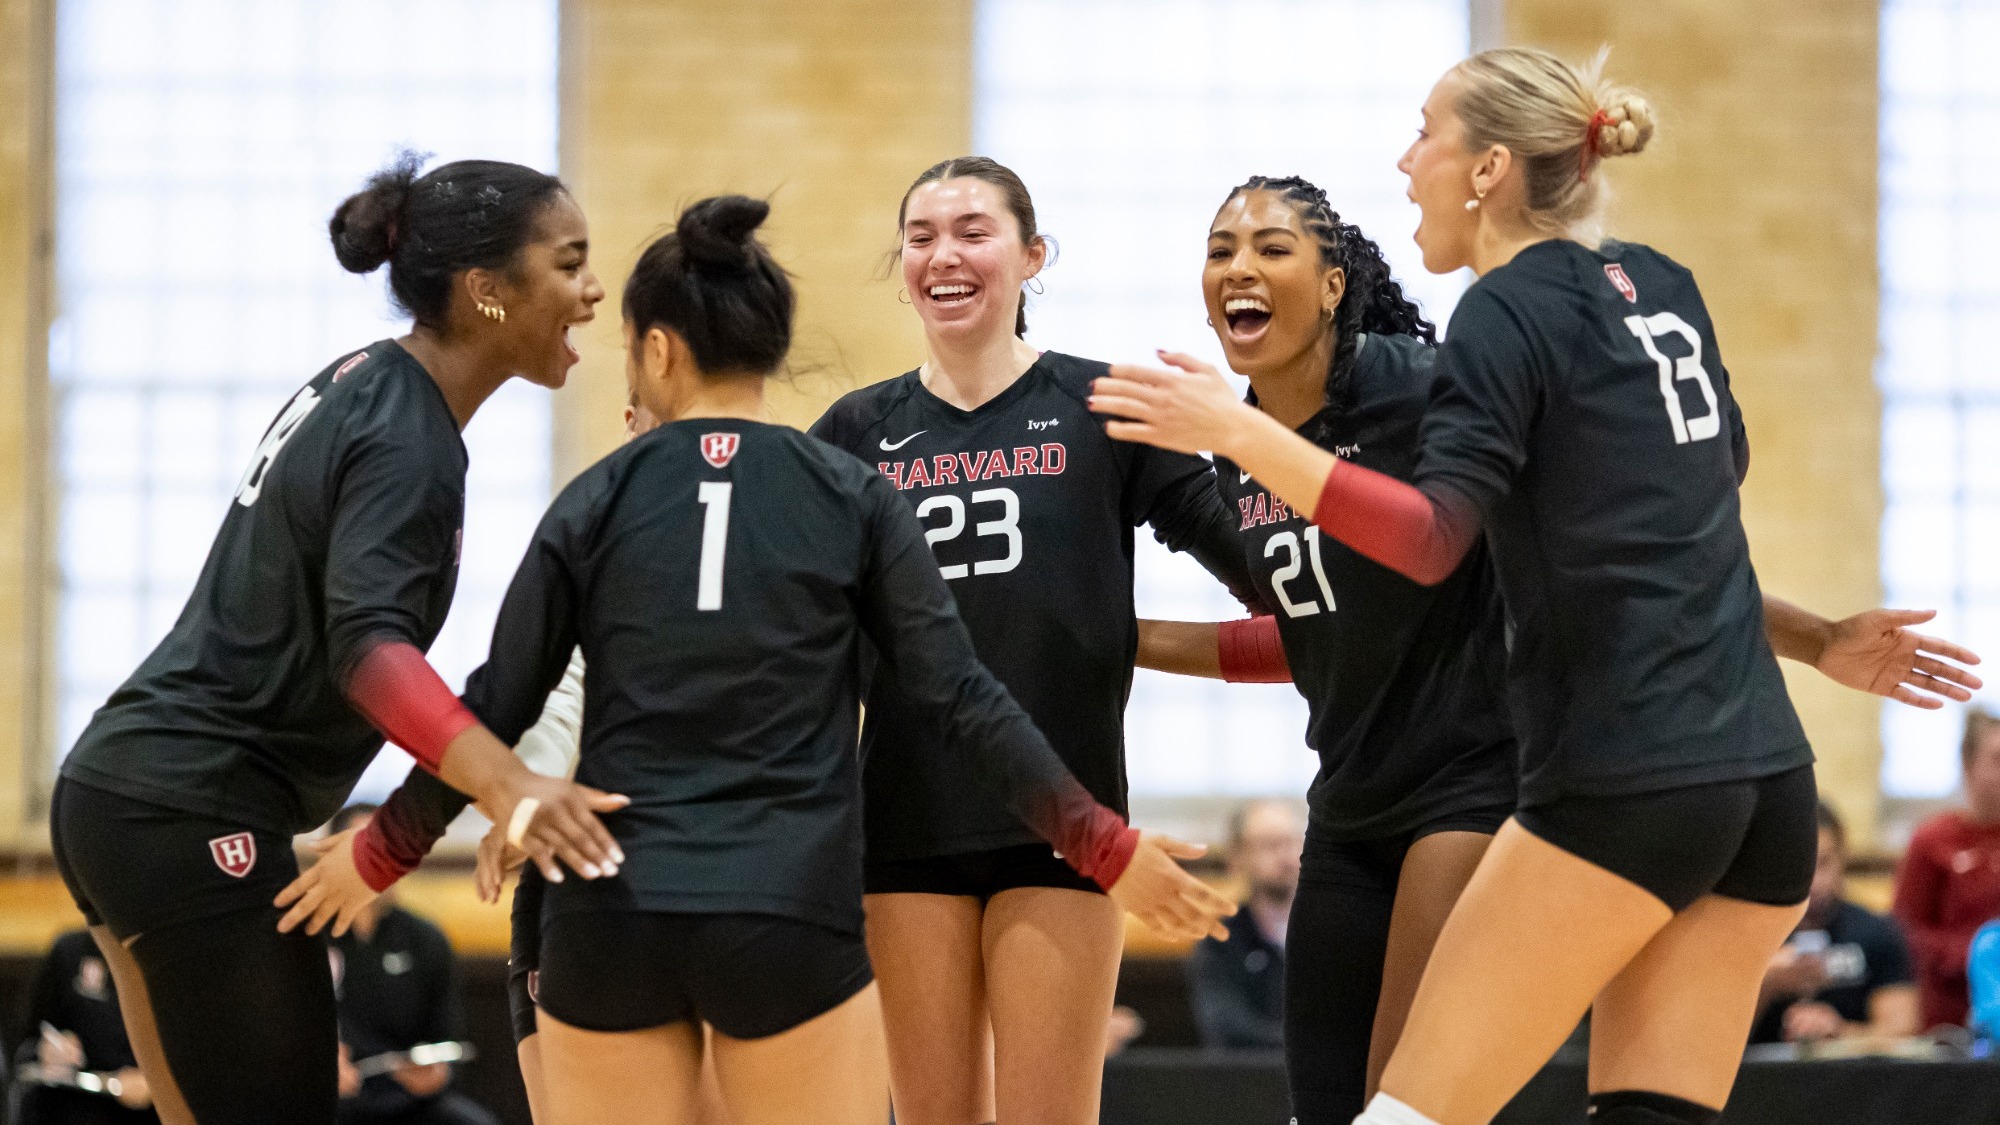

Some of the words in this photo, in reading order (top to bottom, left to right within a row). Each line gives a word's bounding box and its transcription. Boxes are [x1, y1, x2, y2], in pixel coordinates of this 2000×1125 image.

[1623, 311, 1721, 445] 13
[709, 436, 730, 459] H
[1027, 419, 1048, 431] Ivy
[878, 442, 1067, 491] HARVARD
[1335, 445, 1351, 458] Ivy
[916, 487, 1023, 580] 23
[1238, 490, 1301, 532] HAR
[697, 481, 733, 611] 1
[1263, 524, 1337, 619] 21
[220, 838, 248, 867] H
